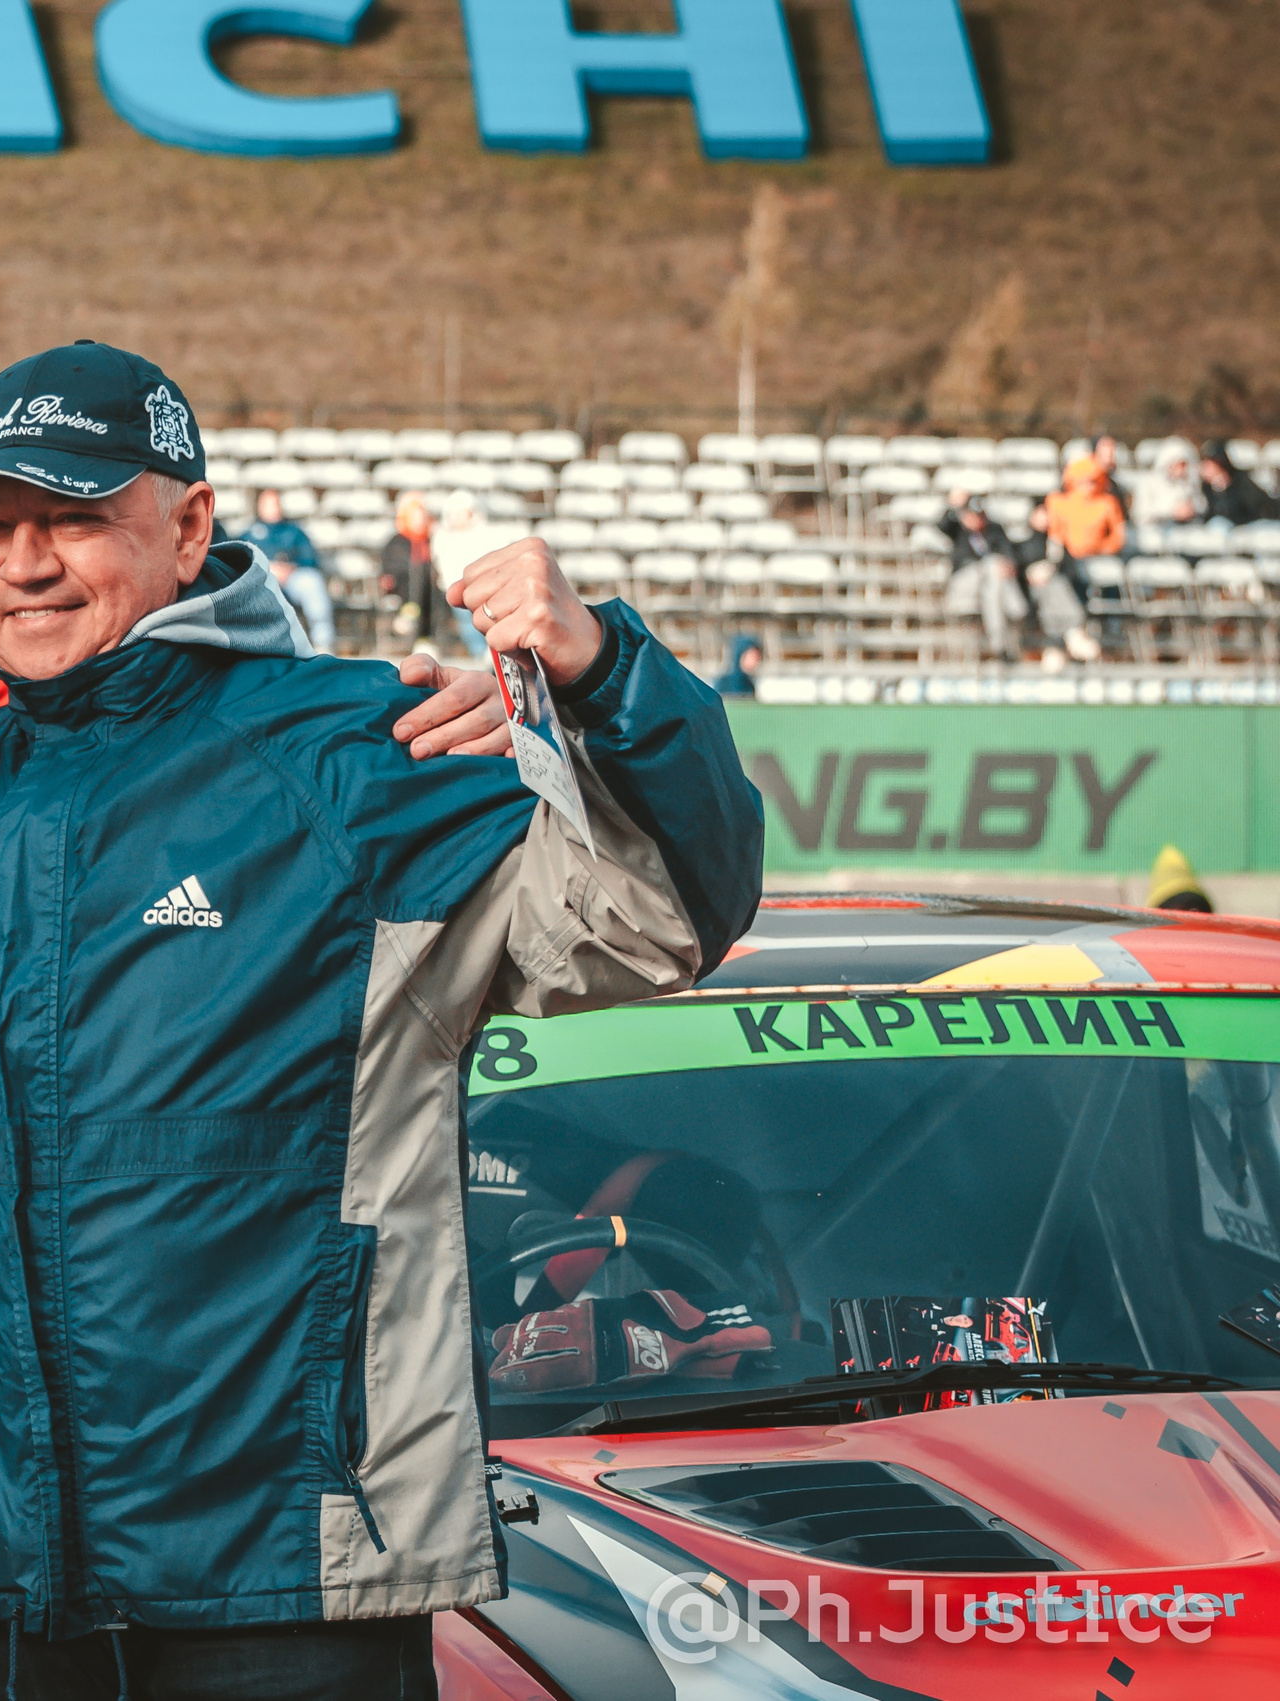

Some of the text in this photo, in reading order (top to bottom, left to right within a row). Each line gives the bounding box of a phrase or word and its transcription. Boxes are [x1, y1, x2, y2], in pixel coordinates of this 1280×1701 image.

[0, 426, 43, 439] FRANCE
[21, 394, 109, 435] Riviera
[142, 904, 223, 928] adidas
[733, 998, 1186, 1054] КАРЕЛИН
[477, 1026, 538, 1082] 8
